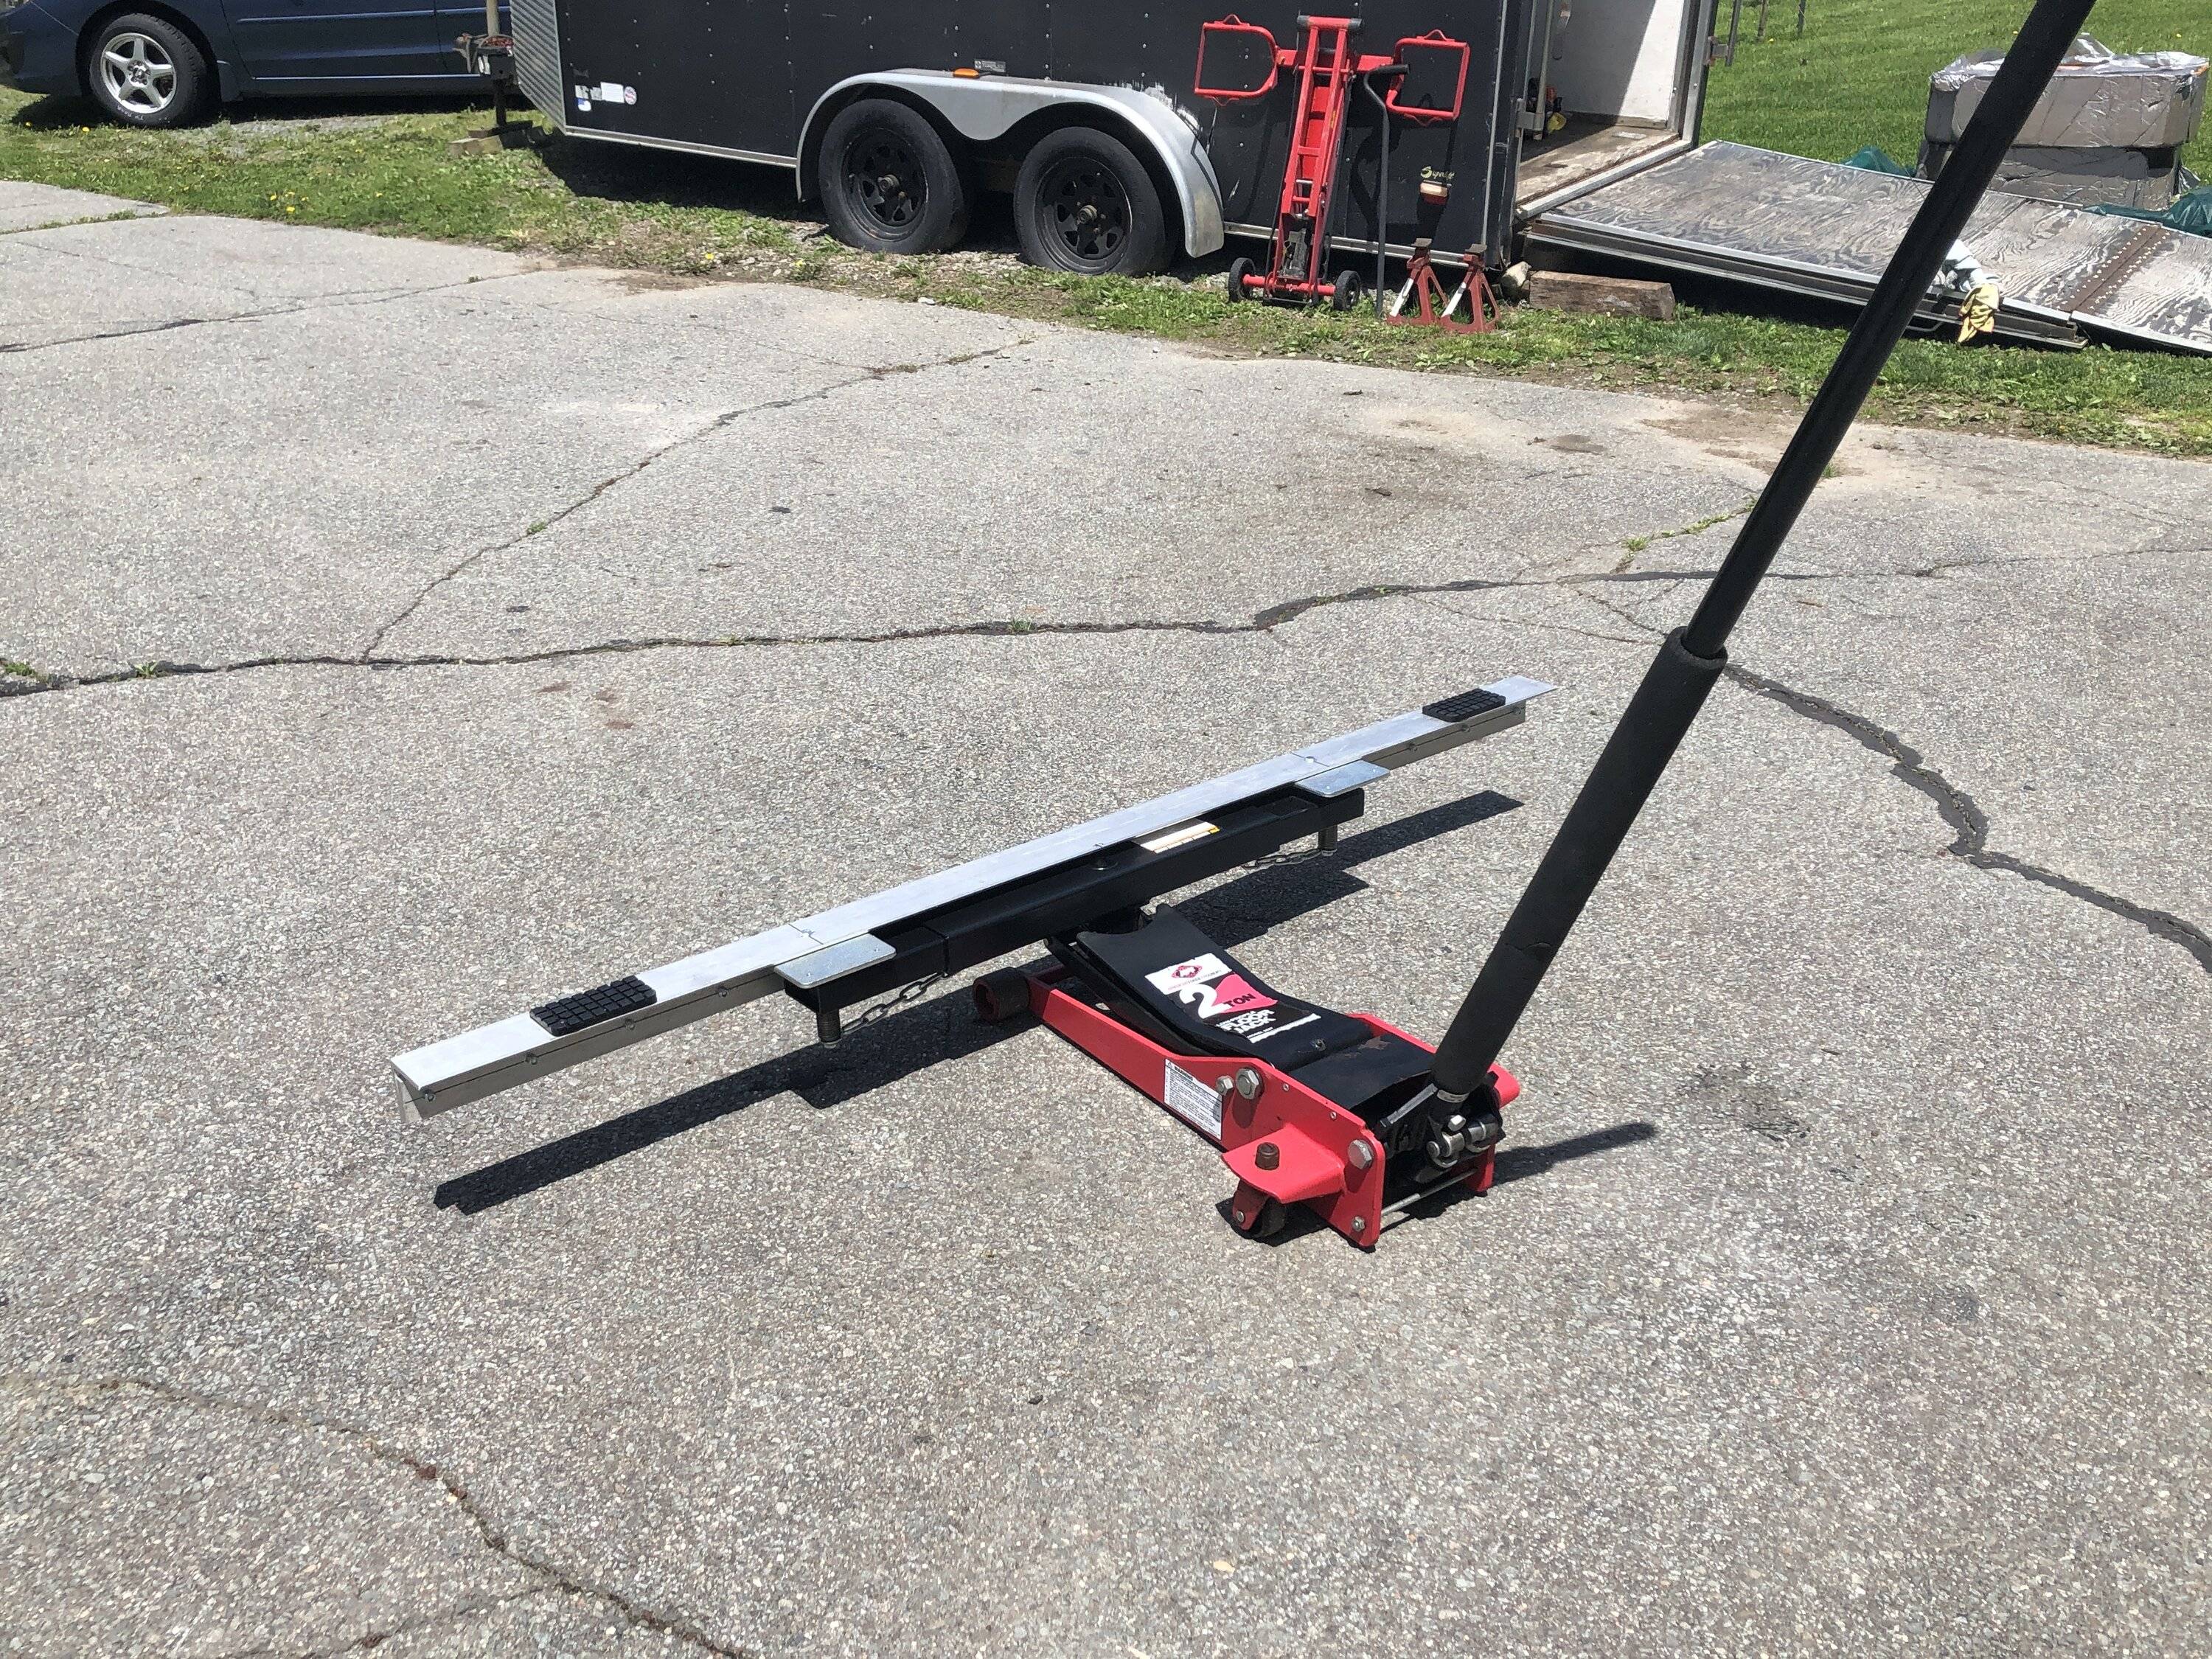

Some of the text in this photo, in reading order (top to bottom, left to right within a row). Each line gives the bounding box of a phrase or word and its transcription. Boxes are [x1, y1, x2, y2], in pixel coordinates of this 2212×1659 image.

[1178, 984, 1256, 1019] 2 TON
[1220, 1009, 1275, 1031] FLOOR
[1234, 1017, 1276, 1034] JACK
